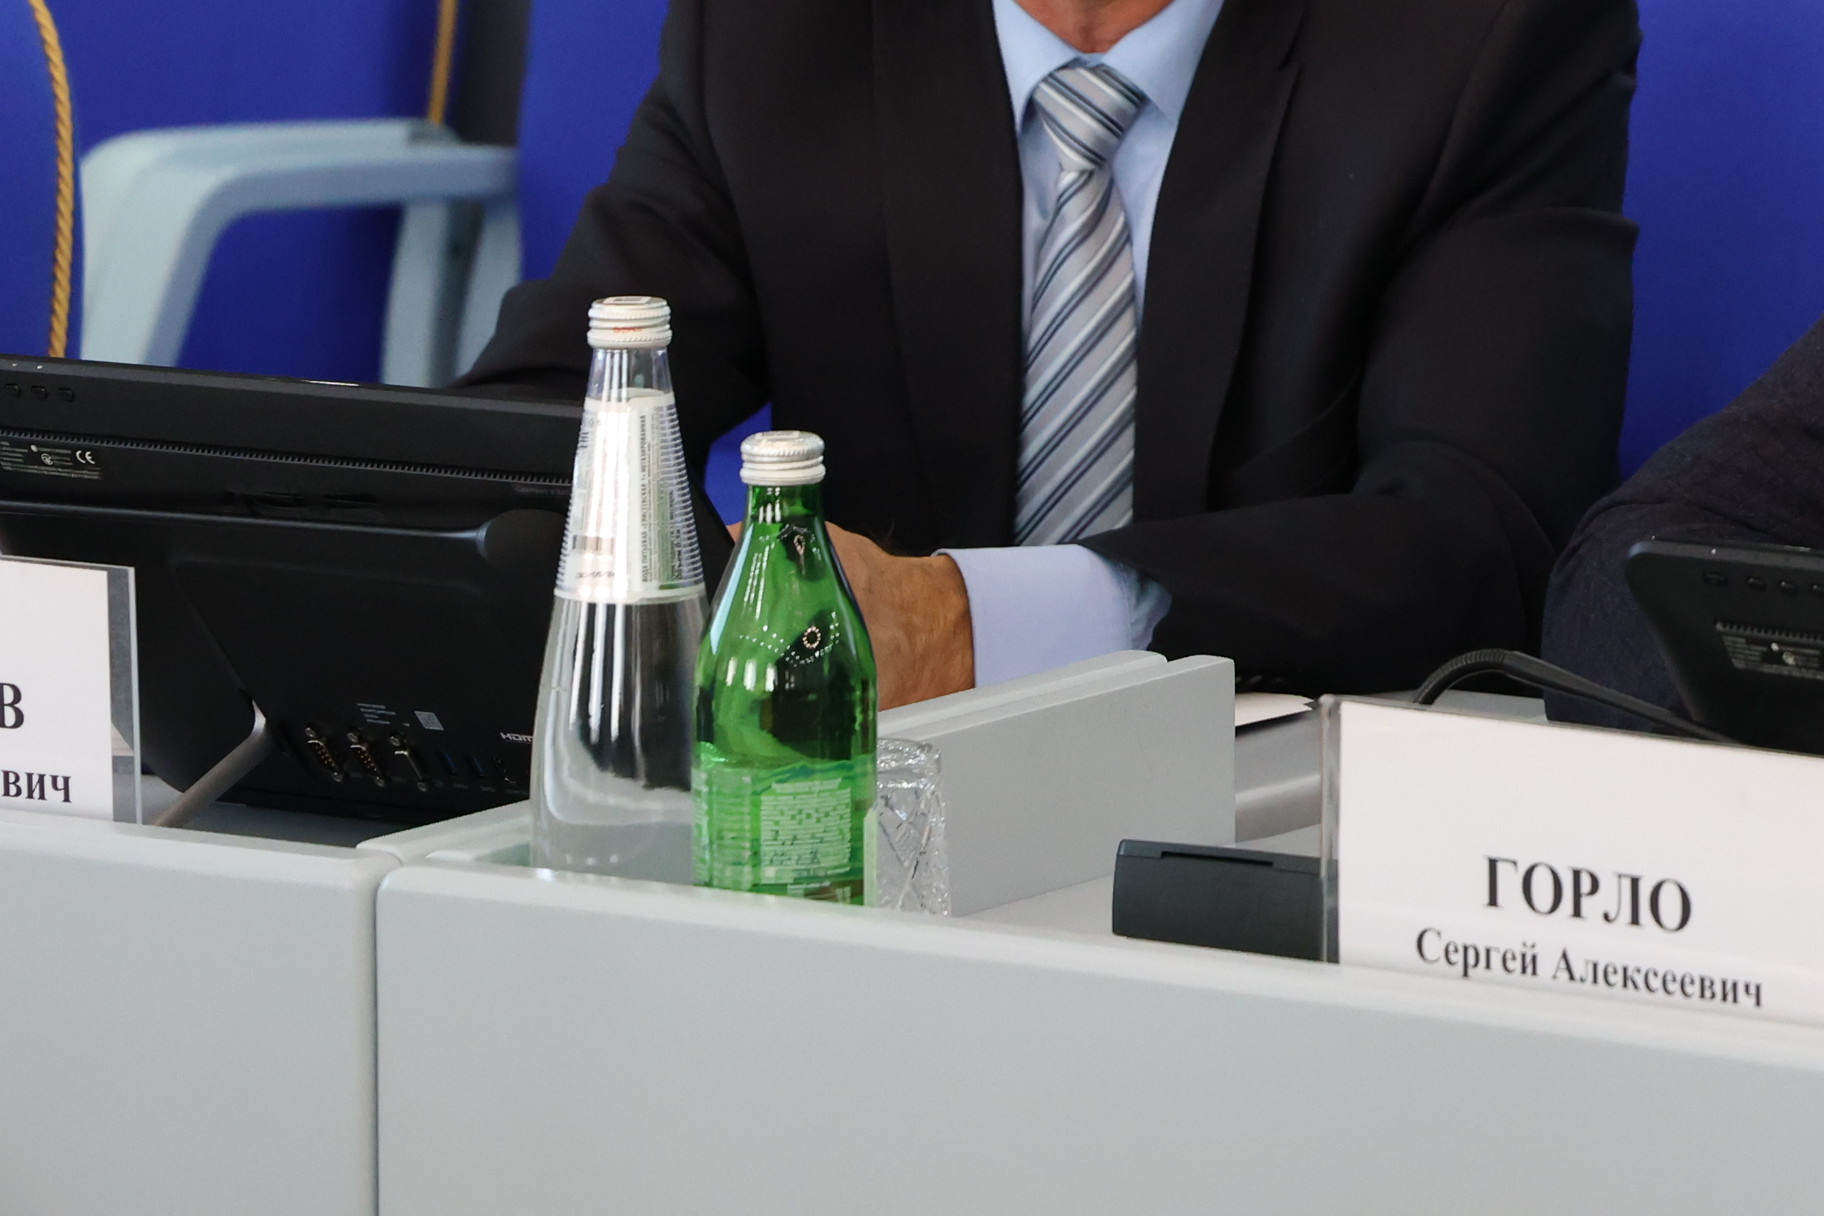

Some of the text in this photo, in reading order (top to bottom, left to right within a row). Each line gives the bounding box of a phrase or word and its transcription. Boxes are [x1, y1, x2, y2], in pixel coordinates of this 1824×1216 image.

[1, 769, 73, 804] вич
[1483, 855, 1692, 933] ГОРЛО
[1416, 927, 1763, 1007] Сергей Алексеевич
